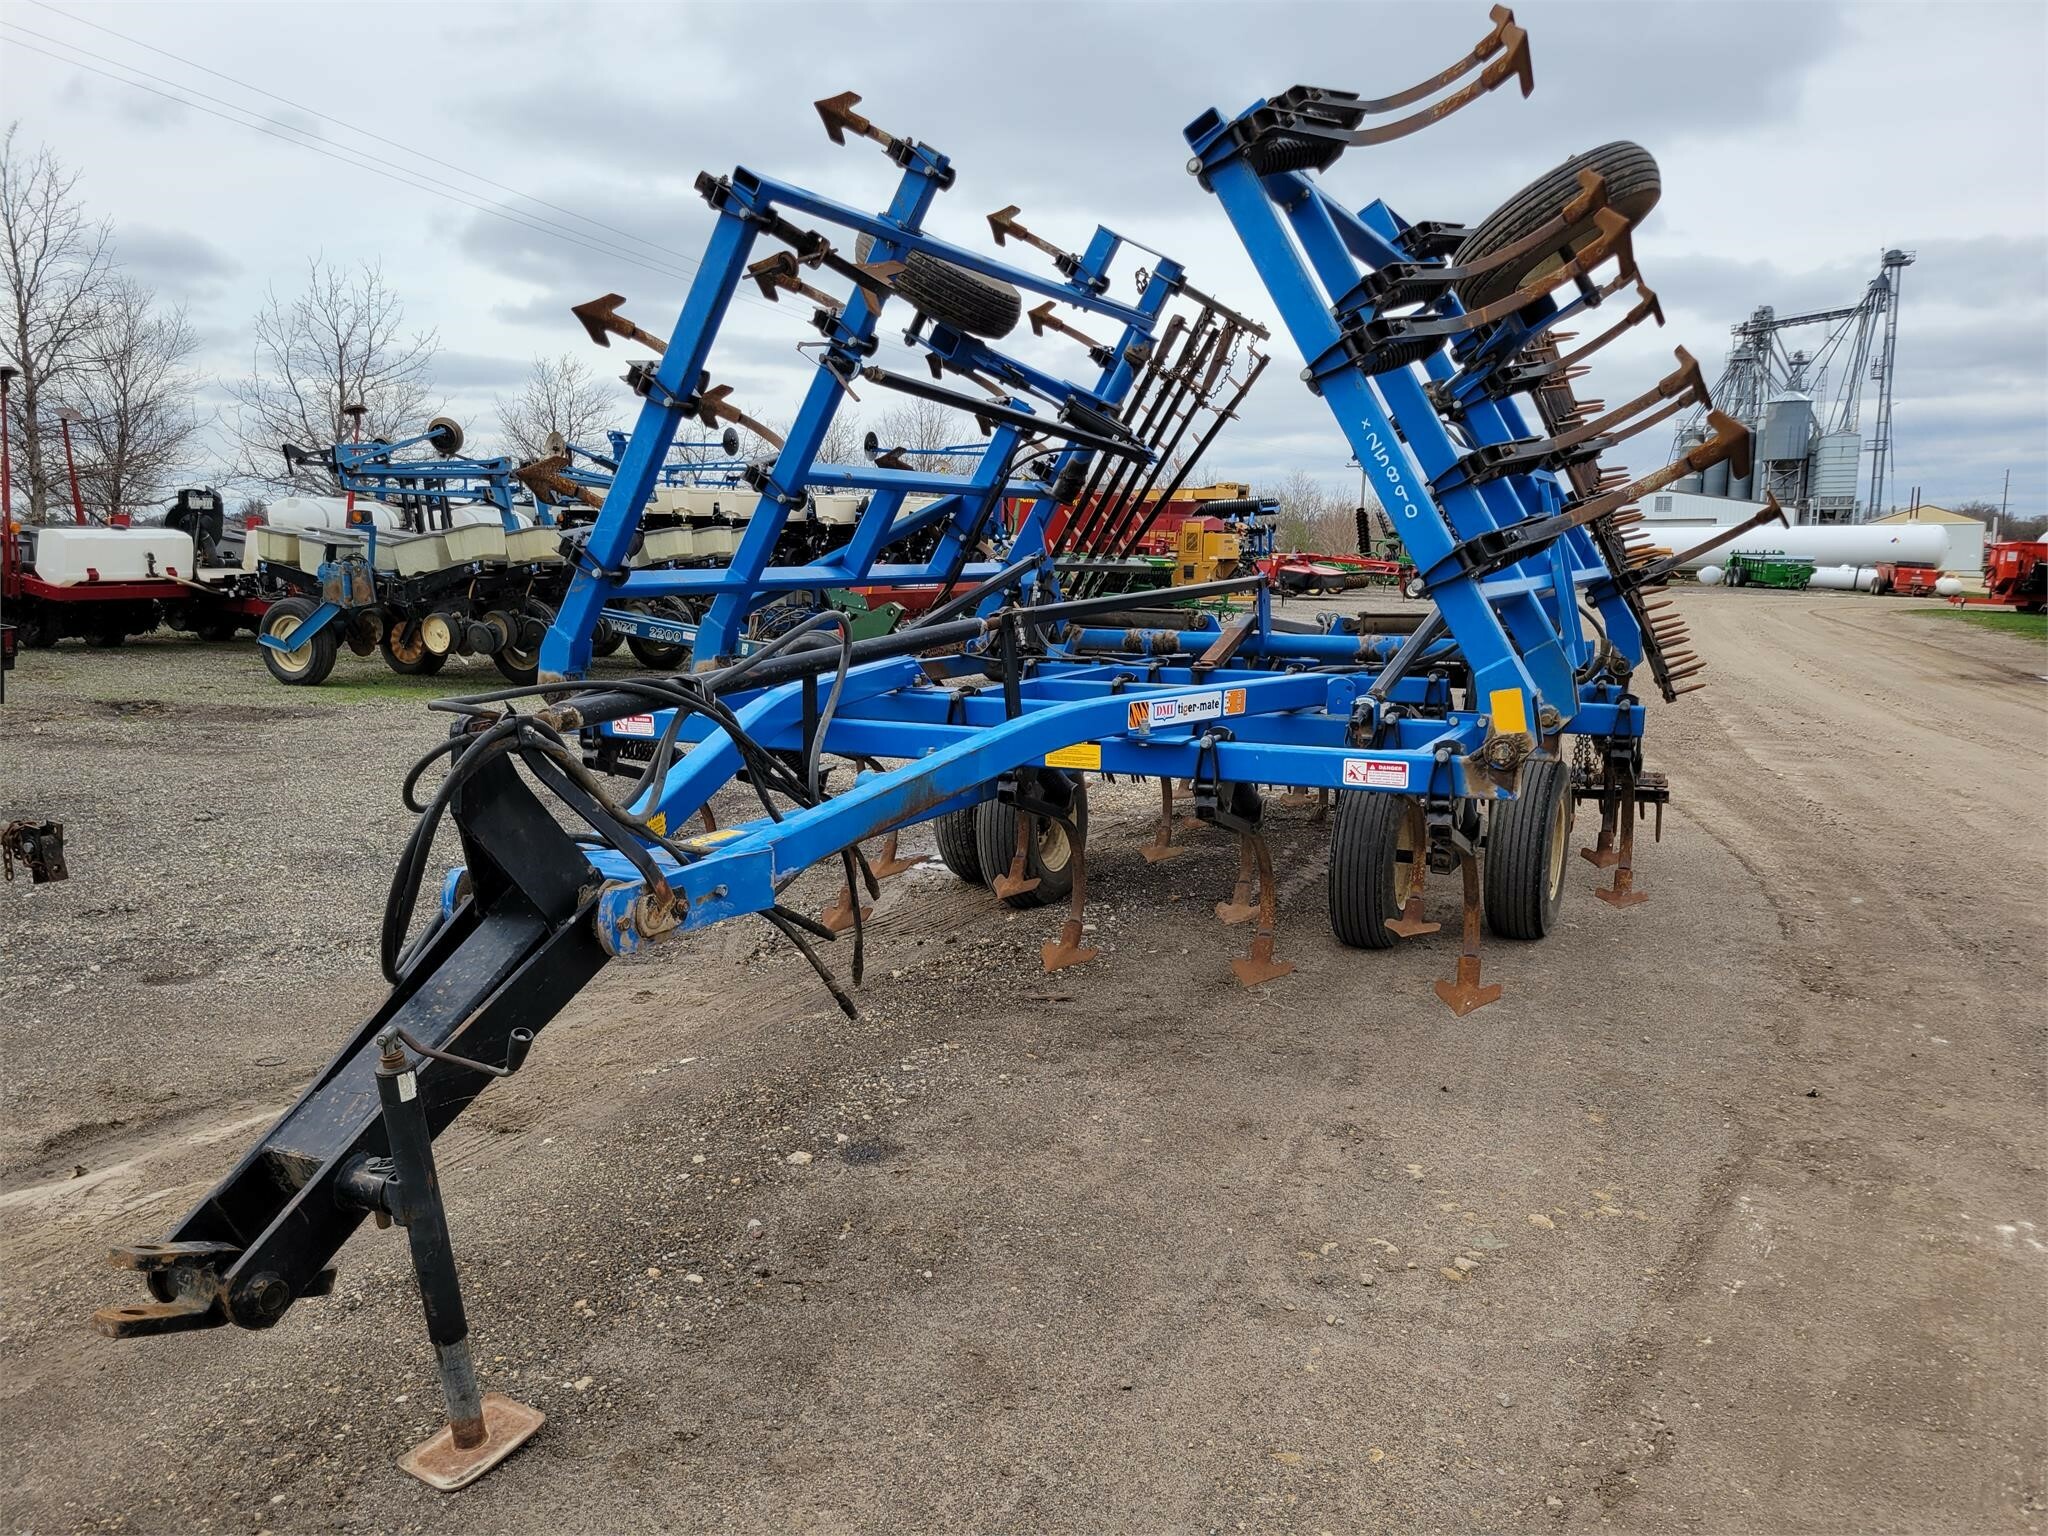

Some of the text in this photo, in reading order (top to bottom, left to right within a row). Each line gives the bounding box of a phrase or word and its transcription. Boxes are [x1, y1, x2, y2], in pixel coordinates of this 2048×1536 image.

[649, 626, 681, 642] 2200
[1156, 699, 1219, 717] DMI tiger-mate
[1378, 764, 1403, 772] DANGER
